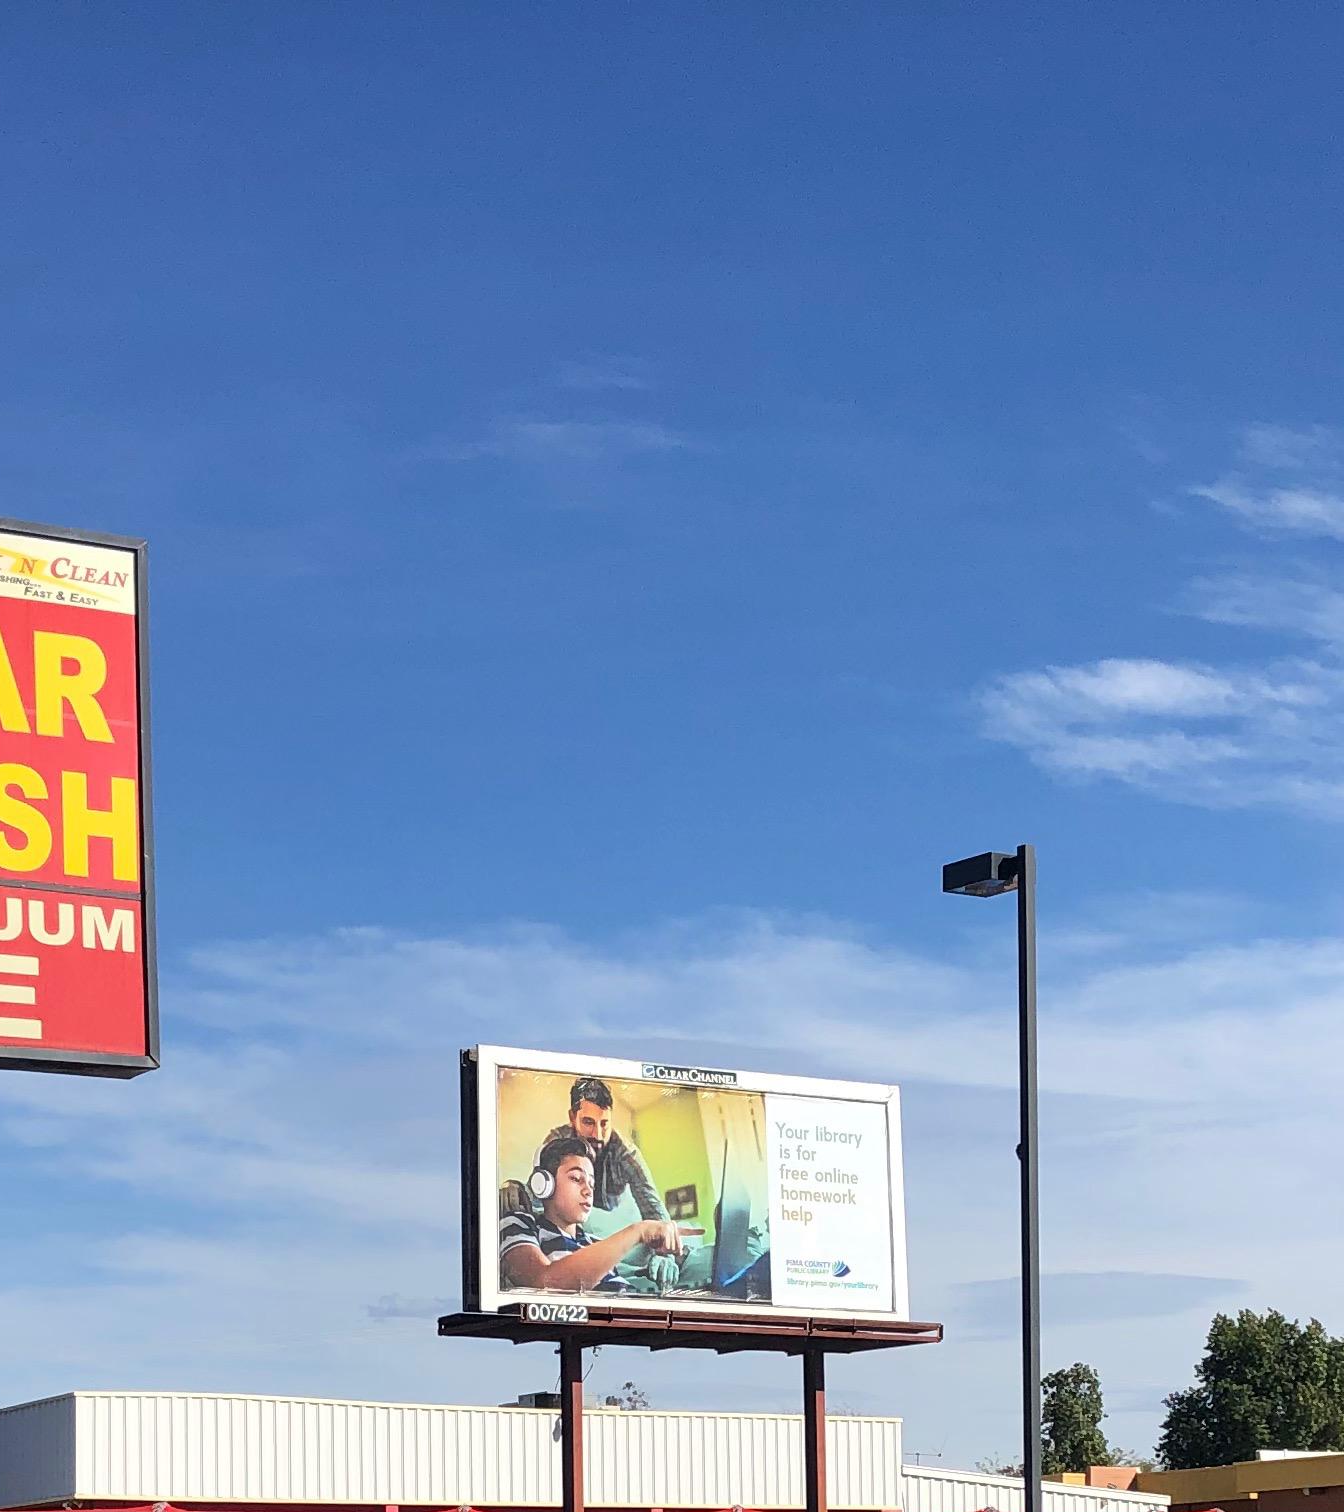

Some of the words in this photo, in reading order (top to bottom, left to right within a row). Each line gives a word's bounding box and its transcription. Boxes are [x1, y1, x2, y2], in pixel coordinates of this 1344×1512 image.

[18, 558, 38, 575] N
[50, 557, 130, 588] CLEAN
[23, 586, 51, 600] FAST
[56, 590, 65, 601] &
[70, 592, 99, 606] EASY
[775, 1121, 809, 1141] Your
[816, 1126, 862, 1149] library
[779, 1144, 791, 1160] is
[796, 1144, 816, 1161] for
[779, 1163, 808, 1181] free
[815, 1167, 859, 1185] online
[780, 1184, 857, 1205] homework
[781, 1204, 813, 1226] help
[528, 1302, 589, 1323] 007422
